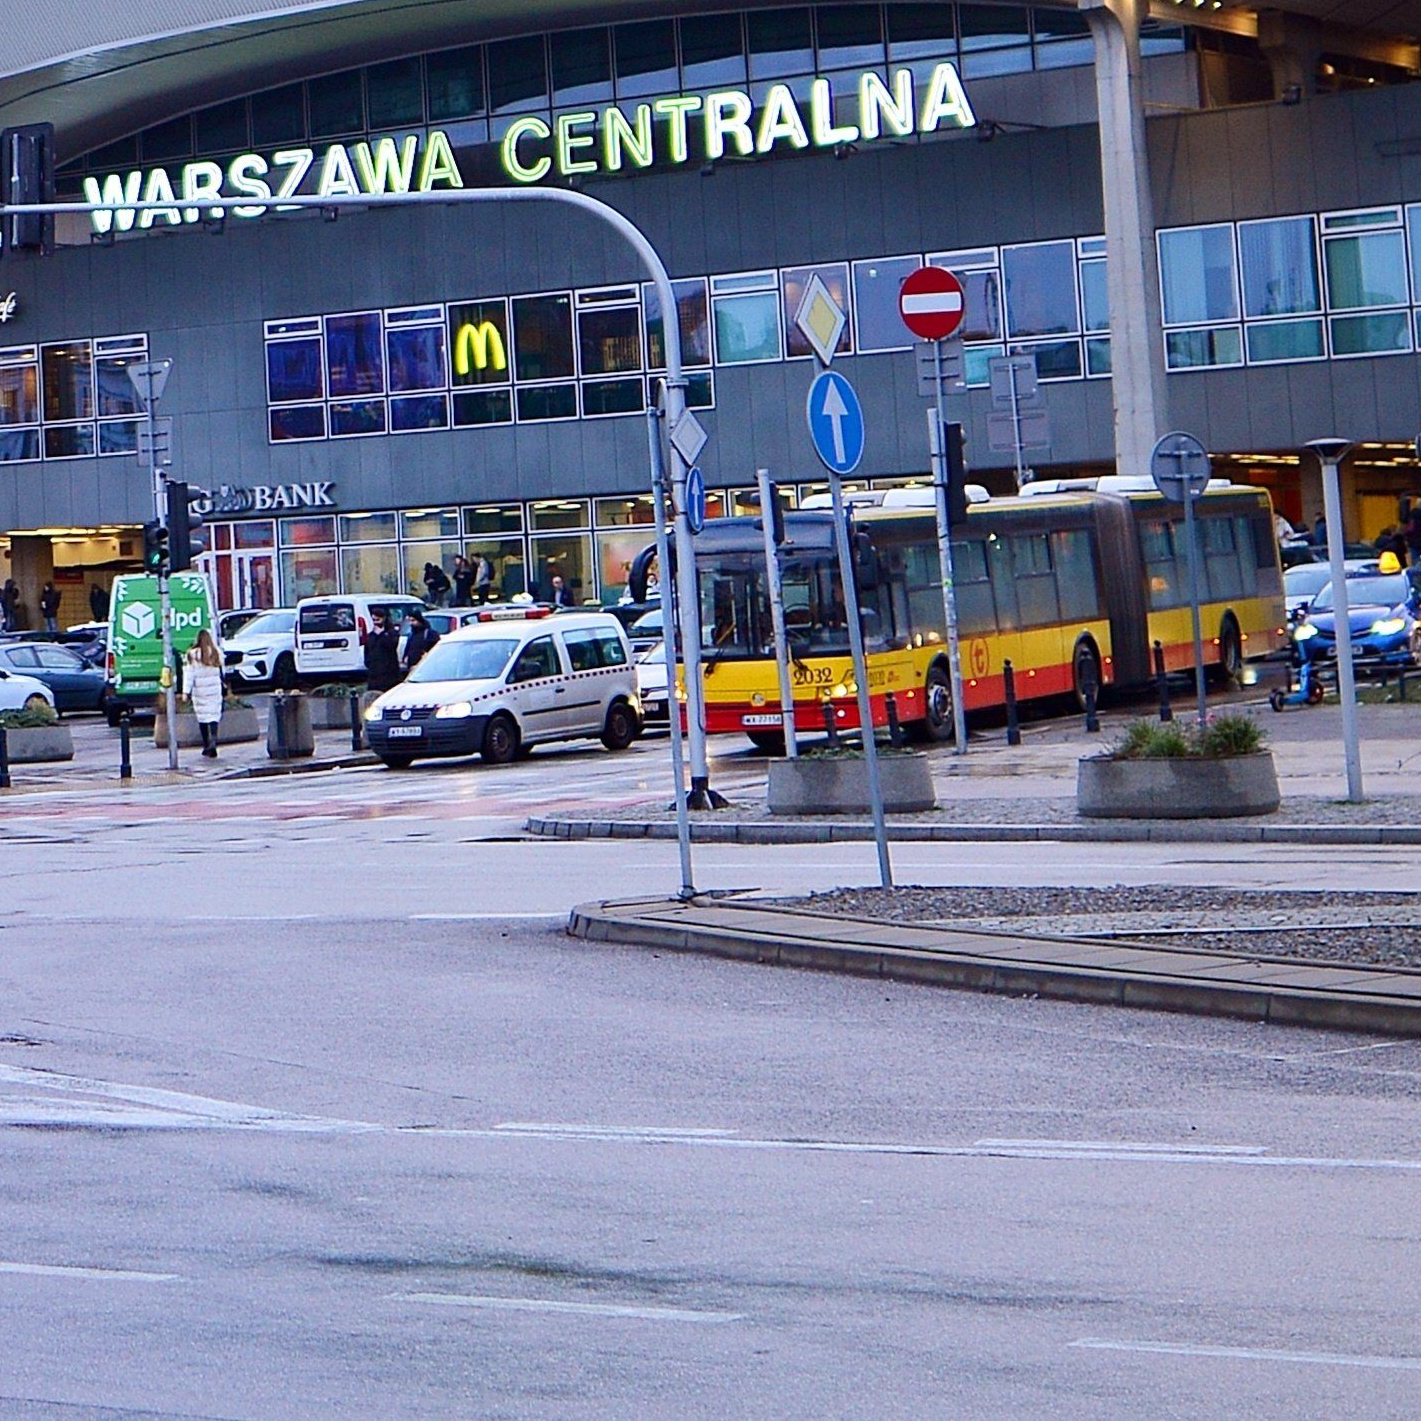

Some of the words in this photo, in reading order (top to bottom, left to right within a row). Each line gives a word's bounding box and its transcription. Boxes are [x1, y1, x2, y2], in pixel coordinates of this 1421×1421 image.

[84, 130, 464, 234] WARSZAWA
[500, 61, 977, 182] CENTRALNA
[254, 482, 335, 510] BANK
[794, 668, 833, 685] 2032
